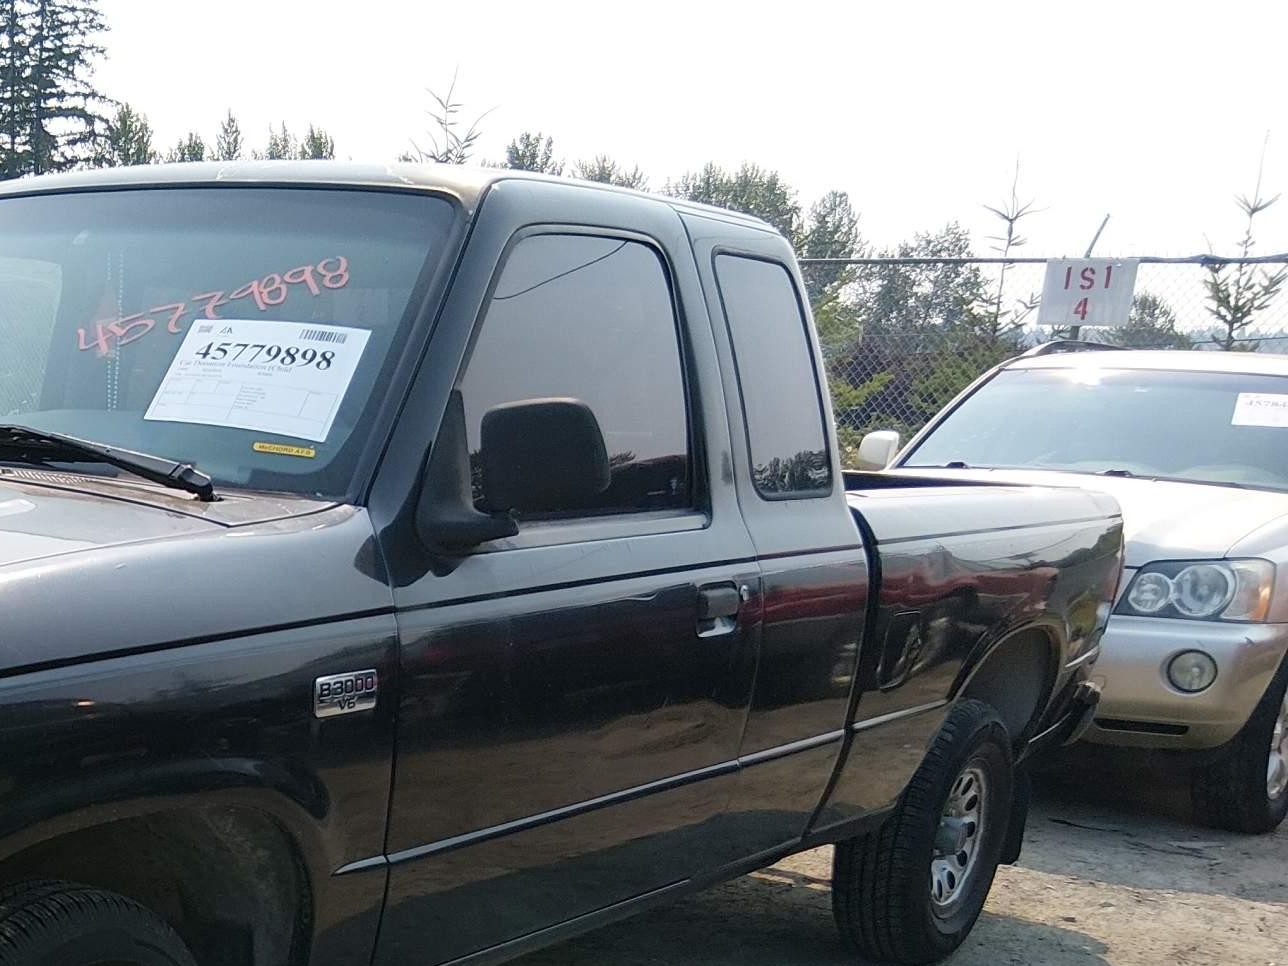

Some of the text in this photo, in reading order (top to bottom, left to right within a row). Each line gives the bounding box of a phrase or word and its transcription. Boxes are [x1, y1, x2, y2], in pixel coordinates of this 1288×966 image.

[76, 255, 350, 354] 45779898
[1073, 297, 1089, 321] 4
[195, 341, 335, 371] 45779898
[320, 676, 373, 698] B3000
[338, 699, 355, 710] V6
